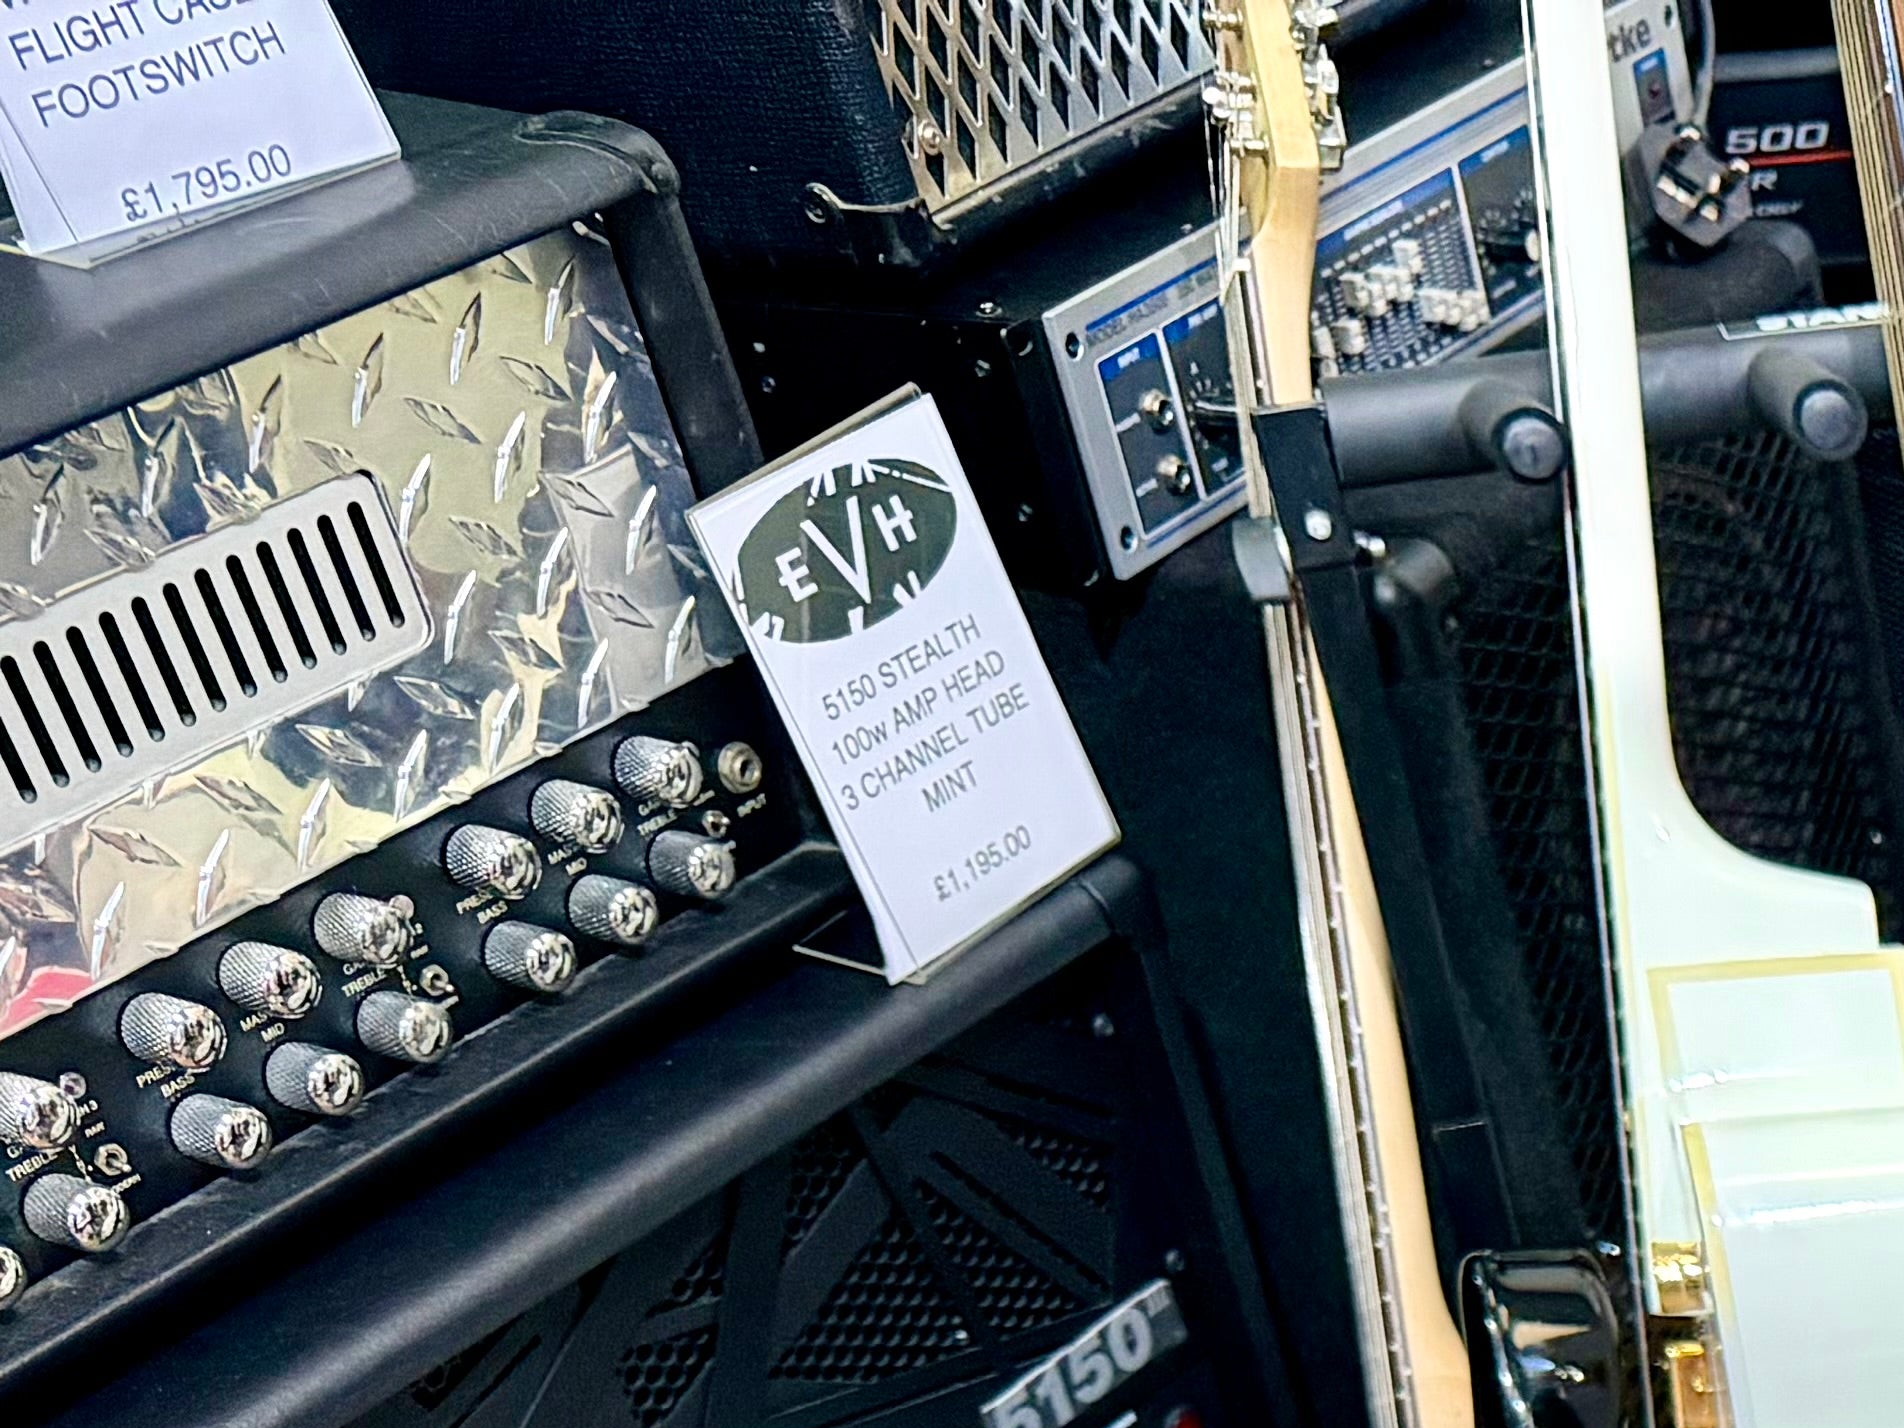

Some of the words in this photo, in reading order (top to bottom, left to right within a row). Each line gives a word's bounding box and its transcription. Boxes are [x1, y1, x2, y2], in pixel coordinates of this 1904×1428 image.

[8, 0, 144, 70] FLIGHT
[31, 21, 286, 128] FOOTSWITCH
[1607, 17, 1650, 63] tke
[1726, 120, 1829, 155] 500
[121, 143, 292, 222] £1,795.00
[775, 495, 918, 603] EVH
[822, 673, 877, 720] 5150
[877, 613, 982, 690] STEALTH
[832, 719, 888, 765] 100w
[896, 686, 938, 734] AMP
[944, 650, 1005, 697] HEAD
[841, 784, 860, 811] 3
[860, 723, 969, 800] CHANNEL
[966, 683, 1031, 732] TUBE
[920, 761, 978, 813] MINT
[932, 824, 1032, 902] £1,195.00
